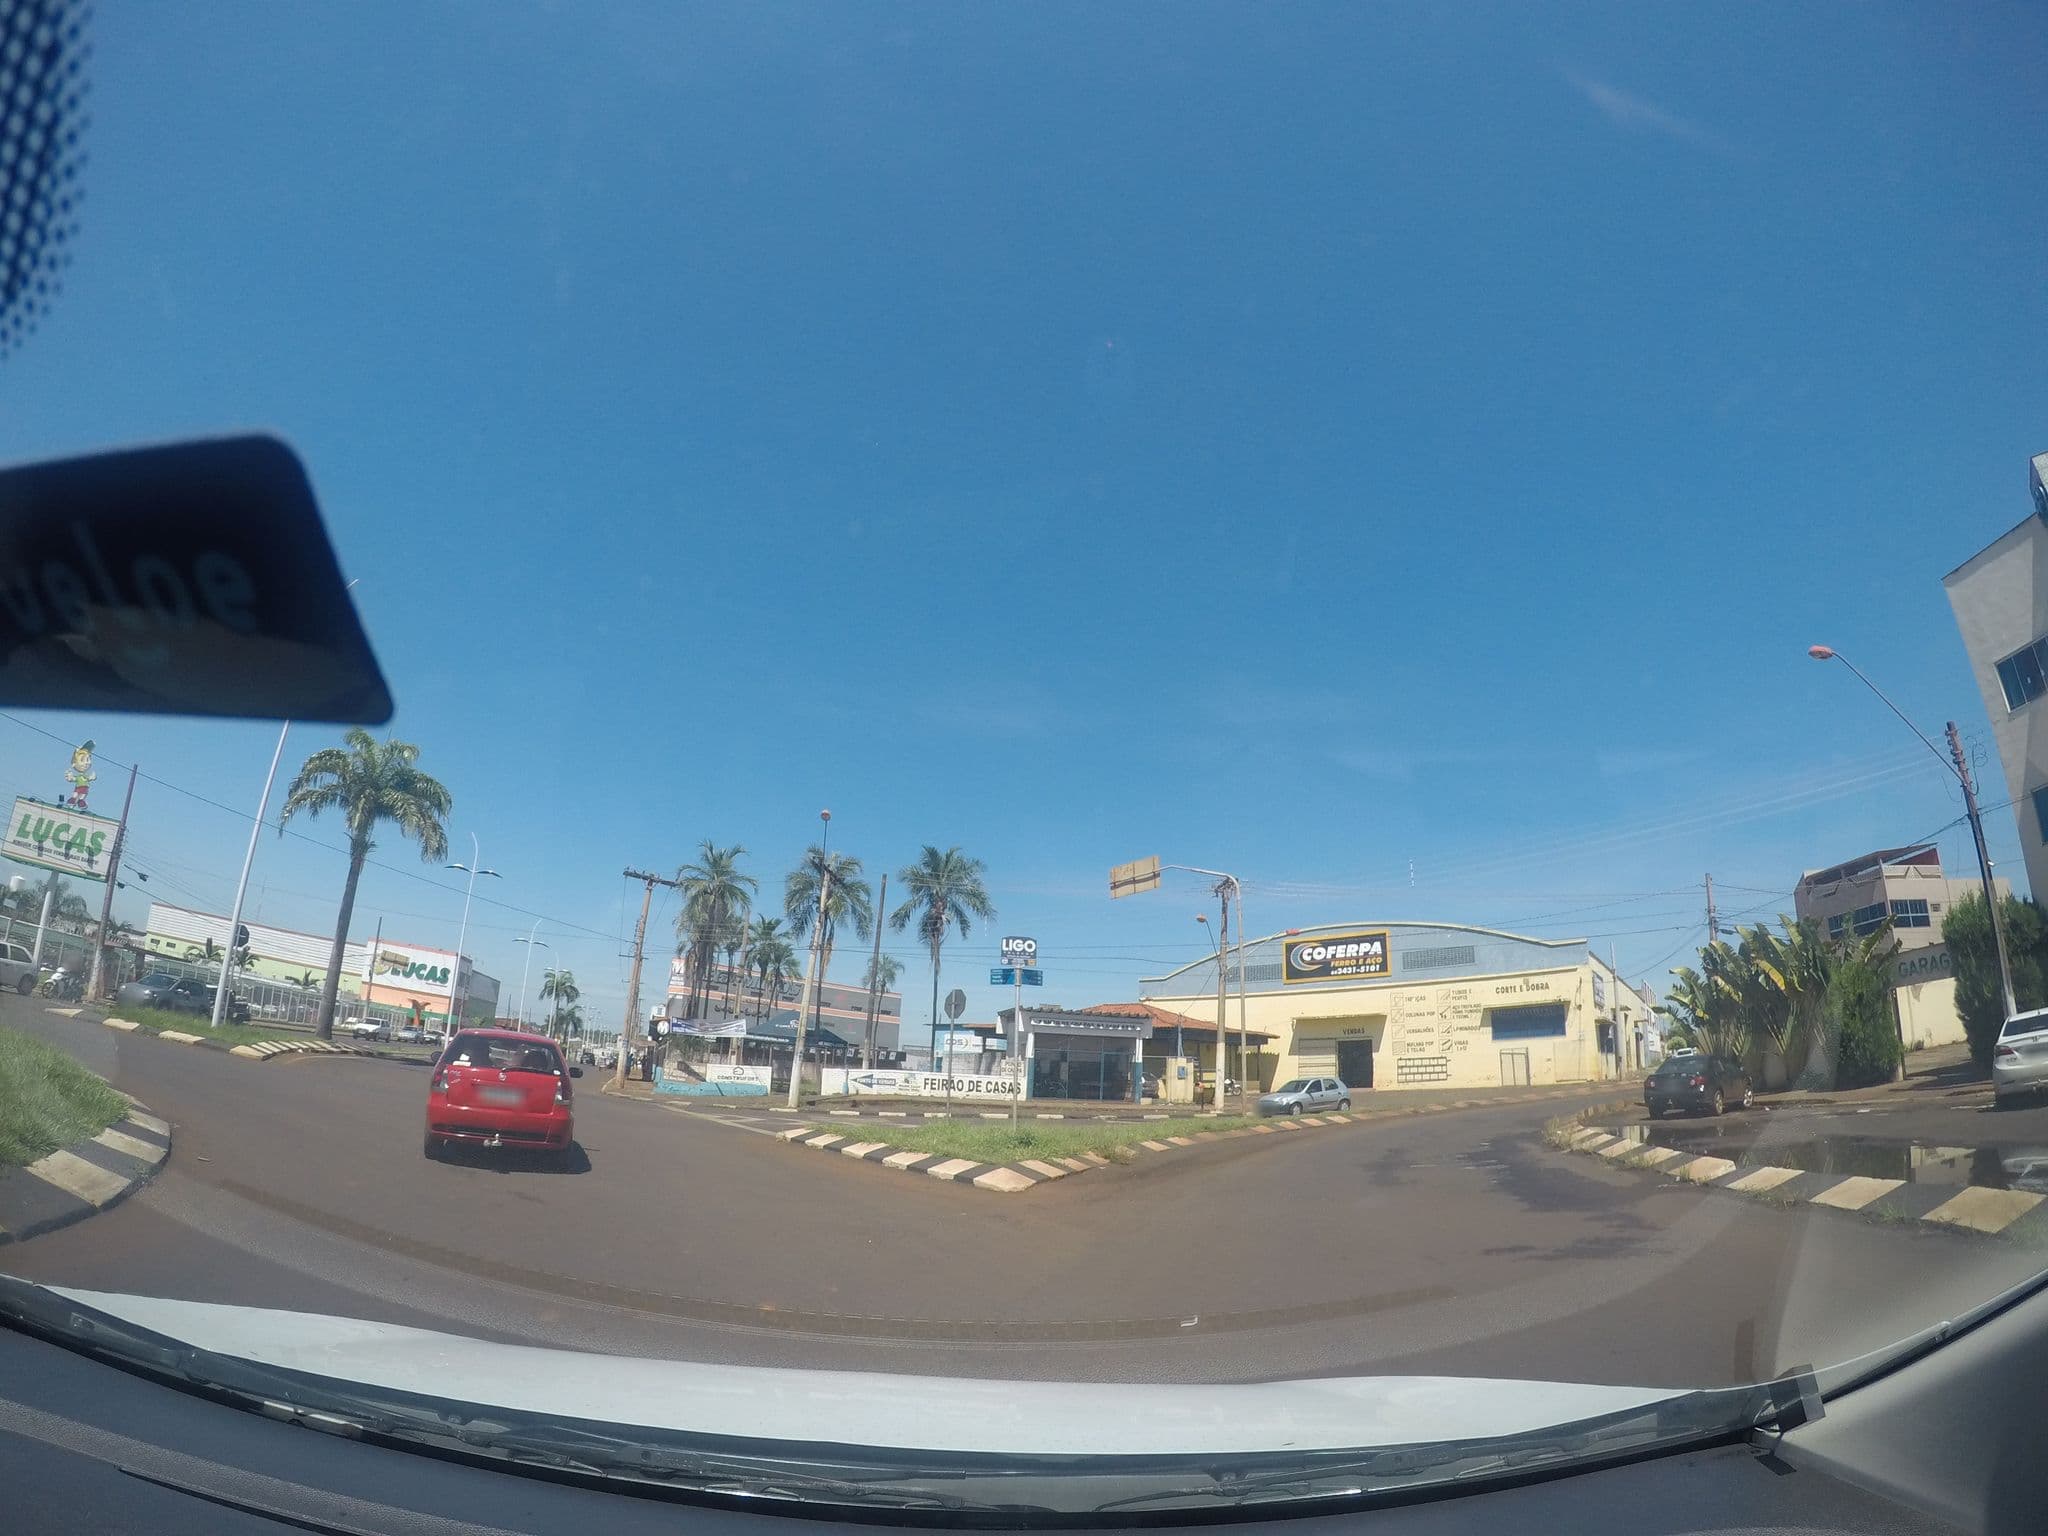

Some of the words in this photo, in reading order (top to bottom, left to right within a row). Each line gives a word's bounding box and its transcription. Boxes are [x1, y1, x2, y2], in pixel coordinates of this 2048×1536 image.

[16, 813, 107, 857] LUCAS
[1002, 939, 1036, 952] LIGO
[1302, 941, 1382, 961] COFERPA
[1331, 959, 1356, 967] FERRO
[1365, 957, 1382, 965] AÇO
[391, 962, 451, 985] LUCAS
[1496, 985, 1516, 994] CORTE
[1519, 984, 1524, 992] E
[1526, 982, 1549, 991] DOBRA
[924, 1076, 963, 1093] FEIRÃO
[968, 1080, 982, 1093] DE
[986, 1081, 1022, 1095] CASAS
